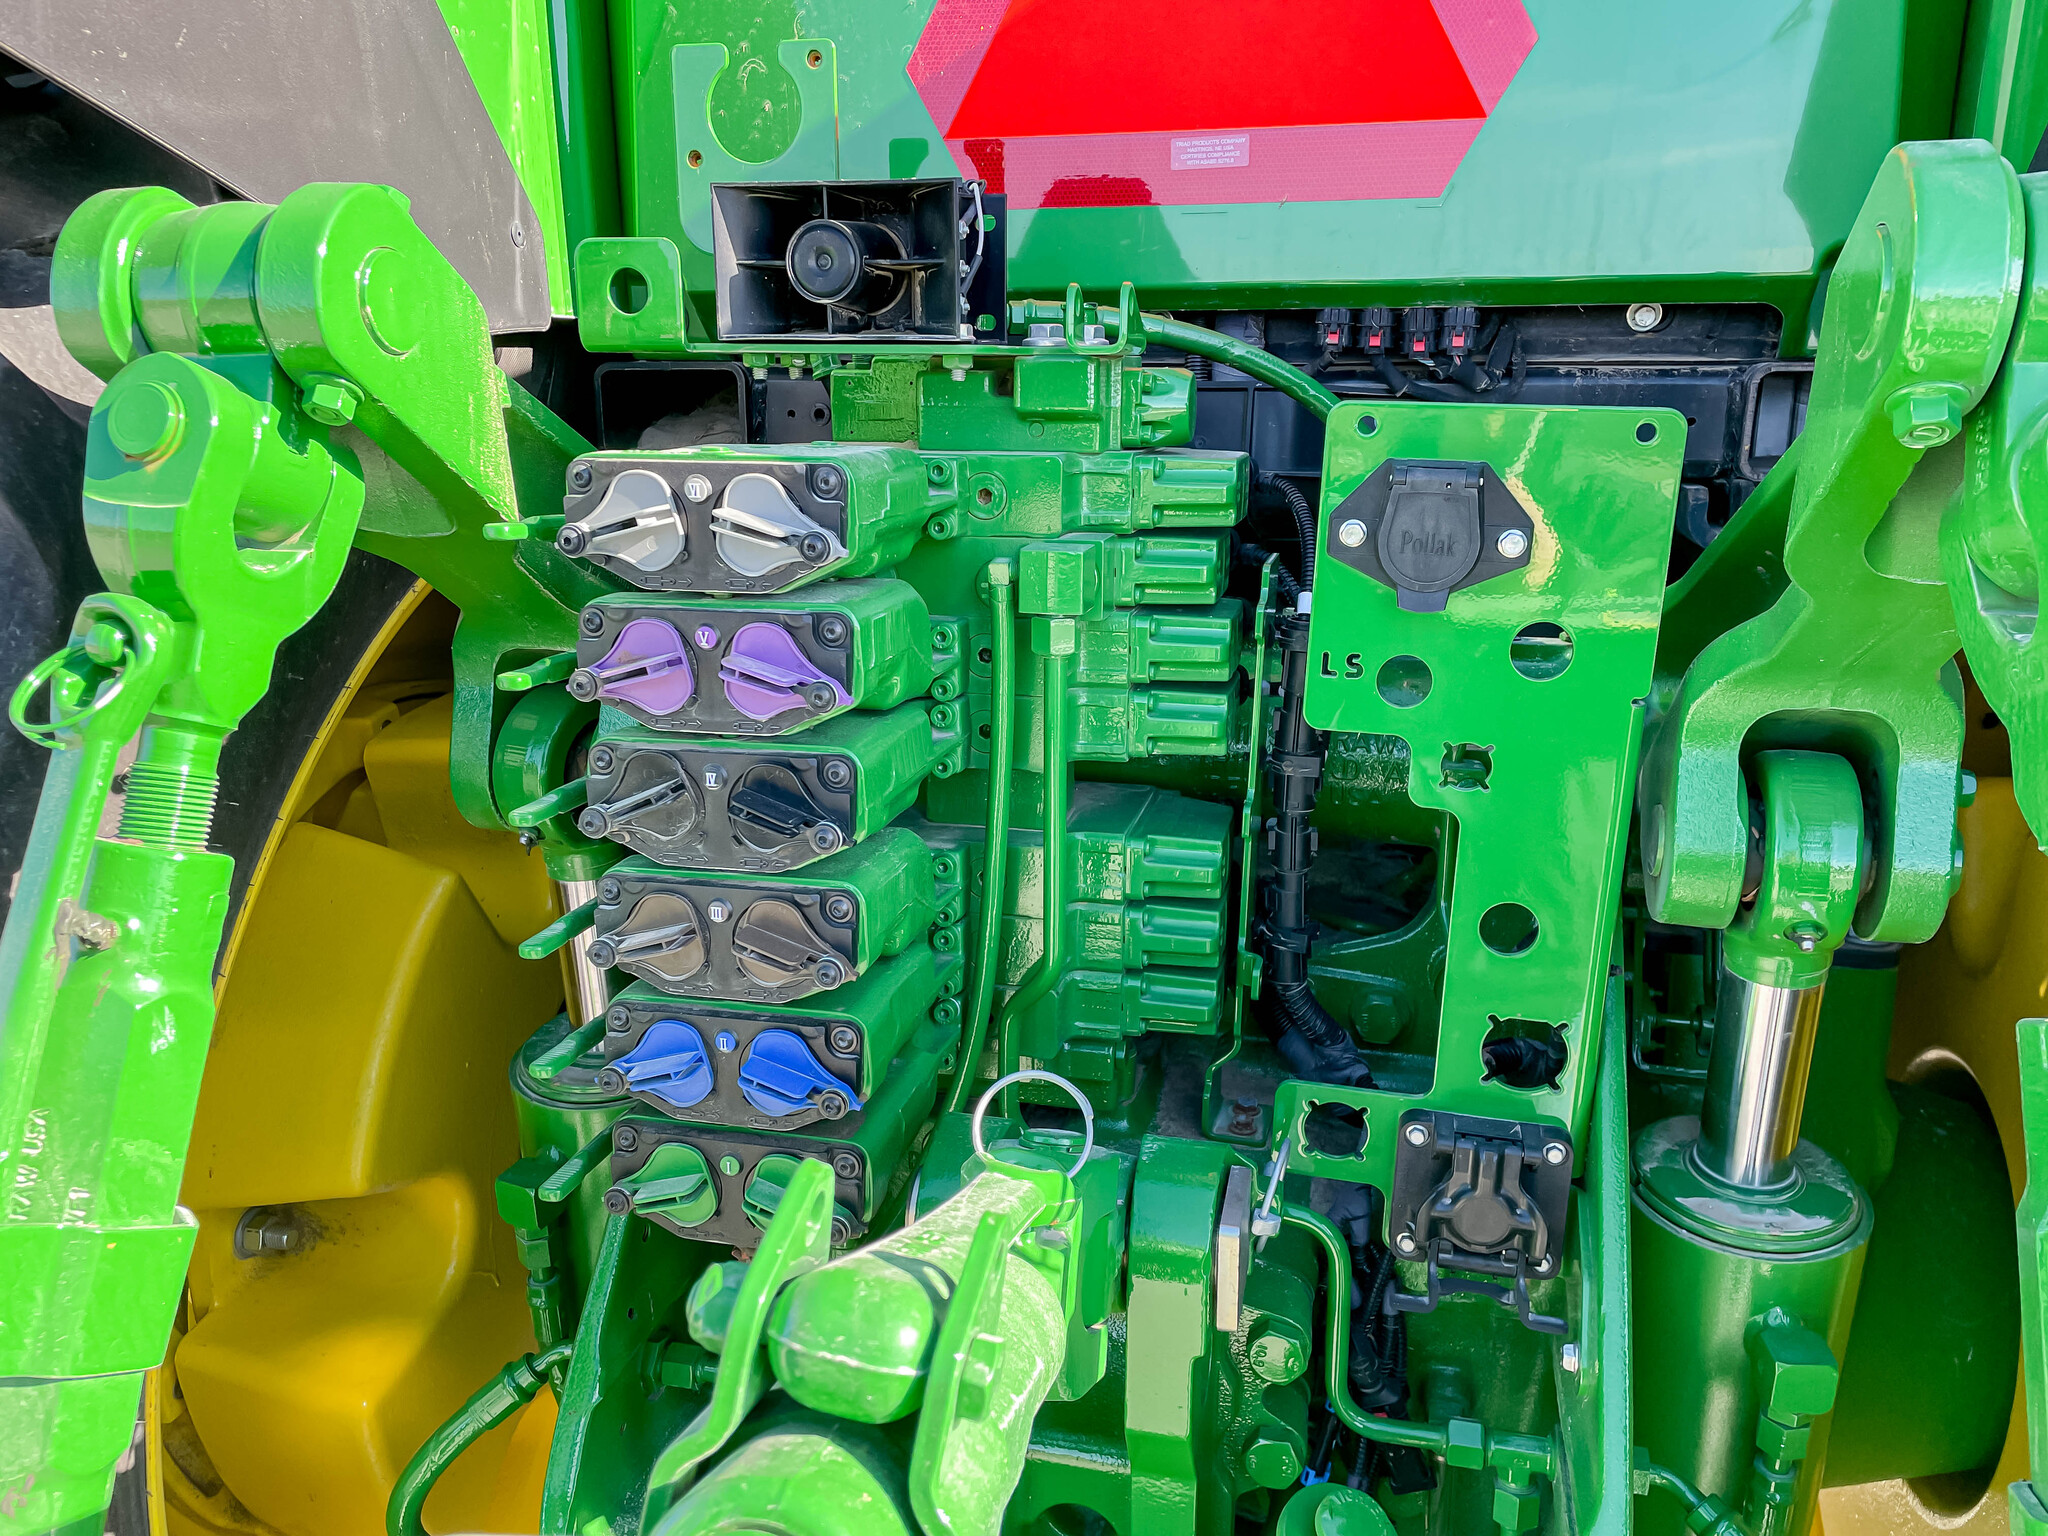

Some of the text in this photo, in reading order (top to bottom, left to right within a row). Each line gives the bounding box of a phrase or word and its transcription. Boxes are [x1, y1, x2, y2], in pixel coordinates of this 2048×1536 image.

[687, 482, 701, 498] VI
[1398, 529, 1458, 557] Pollak
[698, 631, 709, 646] V
[705, 772, 717, 787] IV
[710, 906, 722, 920] III
[719, 1037, 727, 1051] II
[21, 1107, 51, 1157] USA
